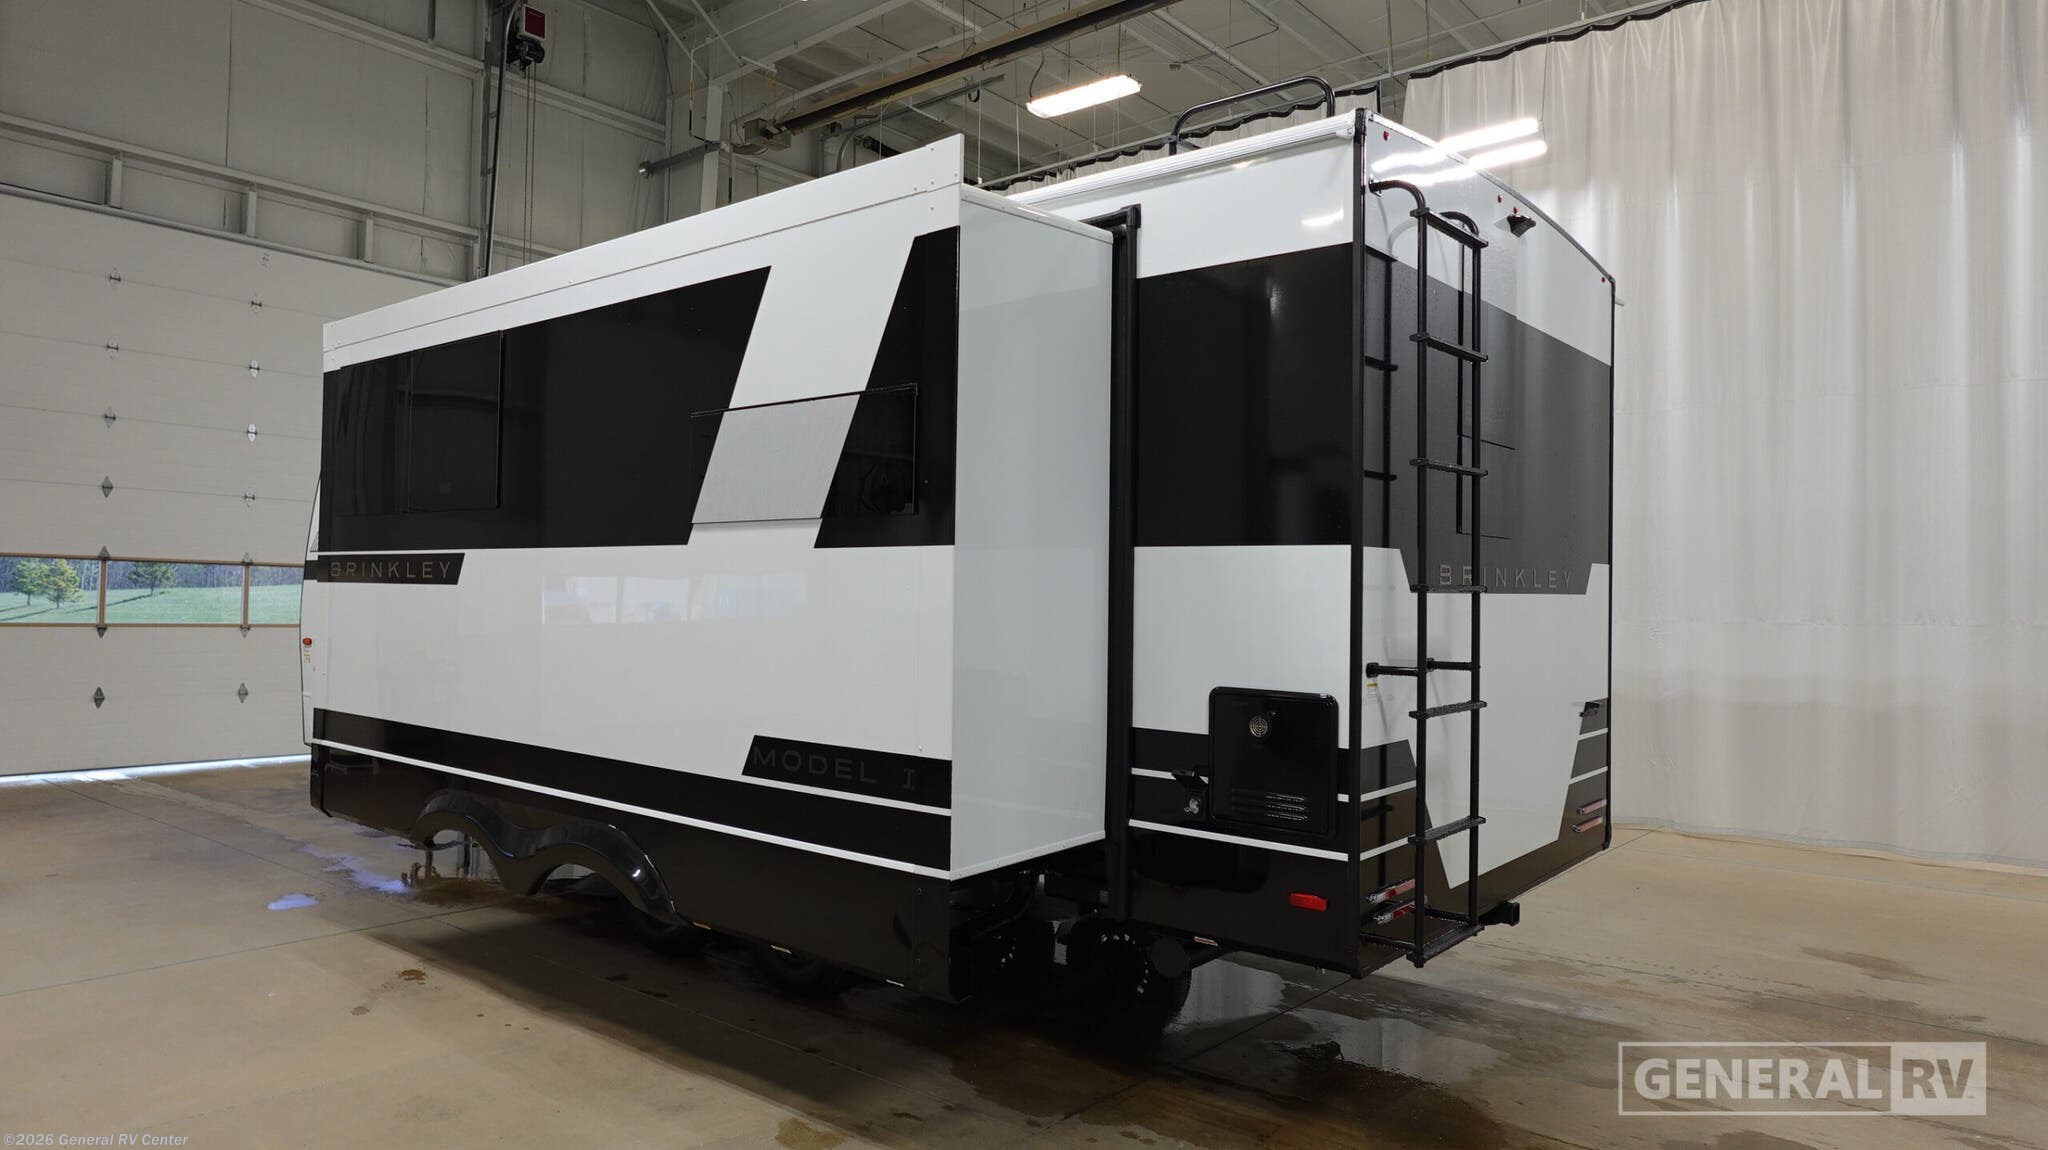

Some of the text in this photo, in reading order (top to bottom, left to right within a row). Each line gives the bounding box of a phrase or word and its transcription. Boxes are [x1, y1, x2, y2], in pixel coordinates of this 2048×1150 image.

[331, 561, 451, 578] BRINKLEY
[1439, 563, 1574, 588] BRINKLEY
[752, 747, 916, 790] MODEL I
